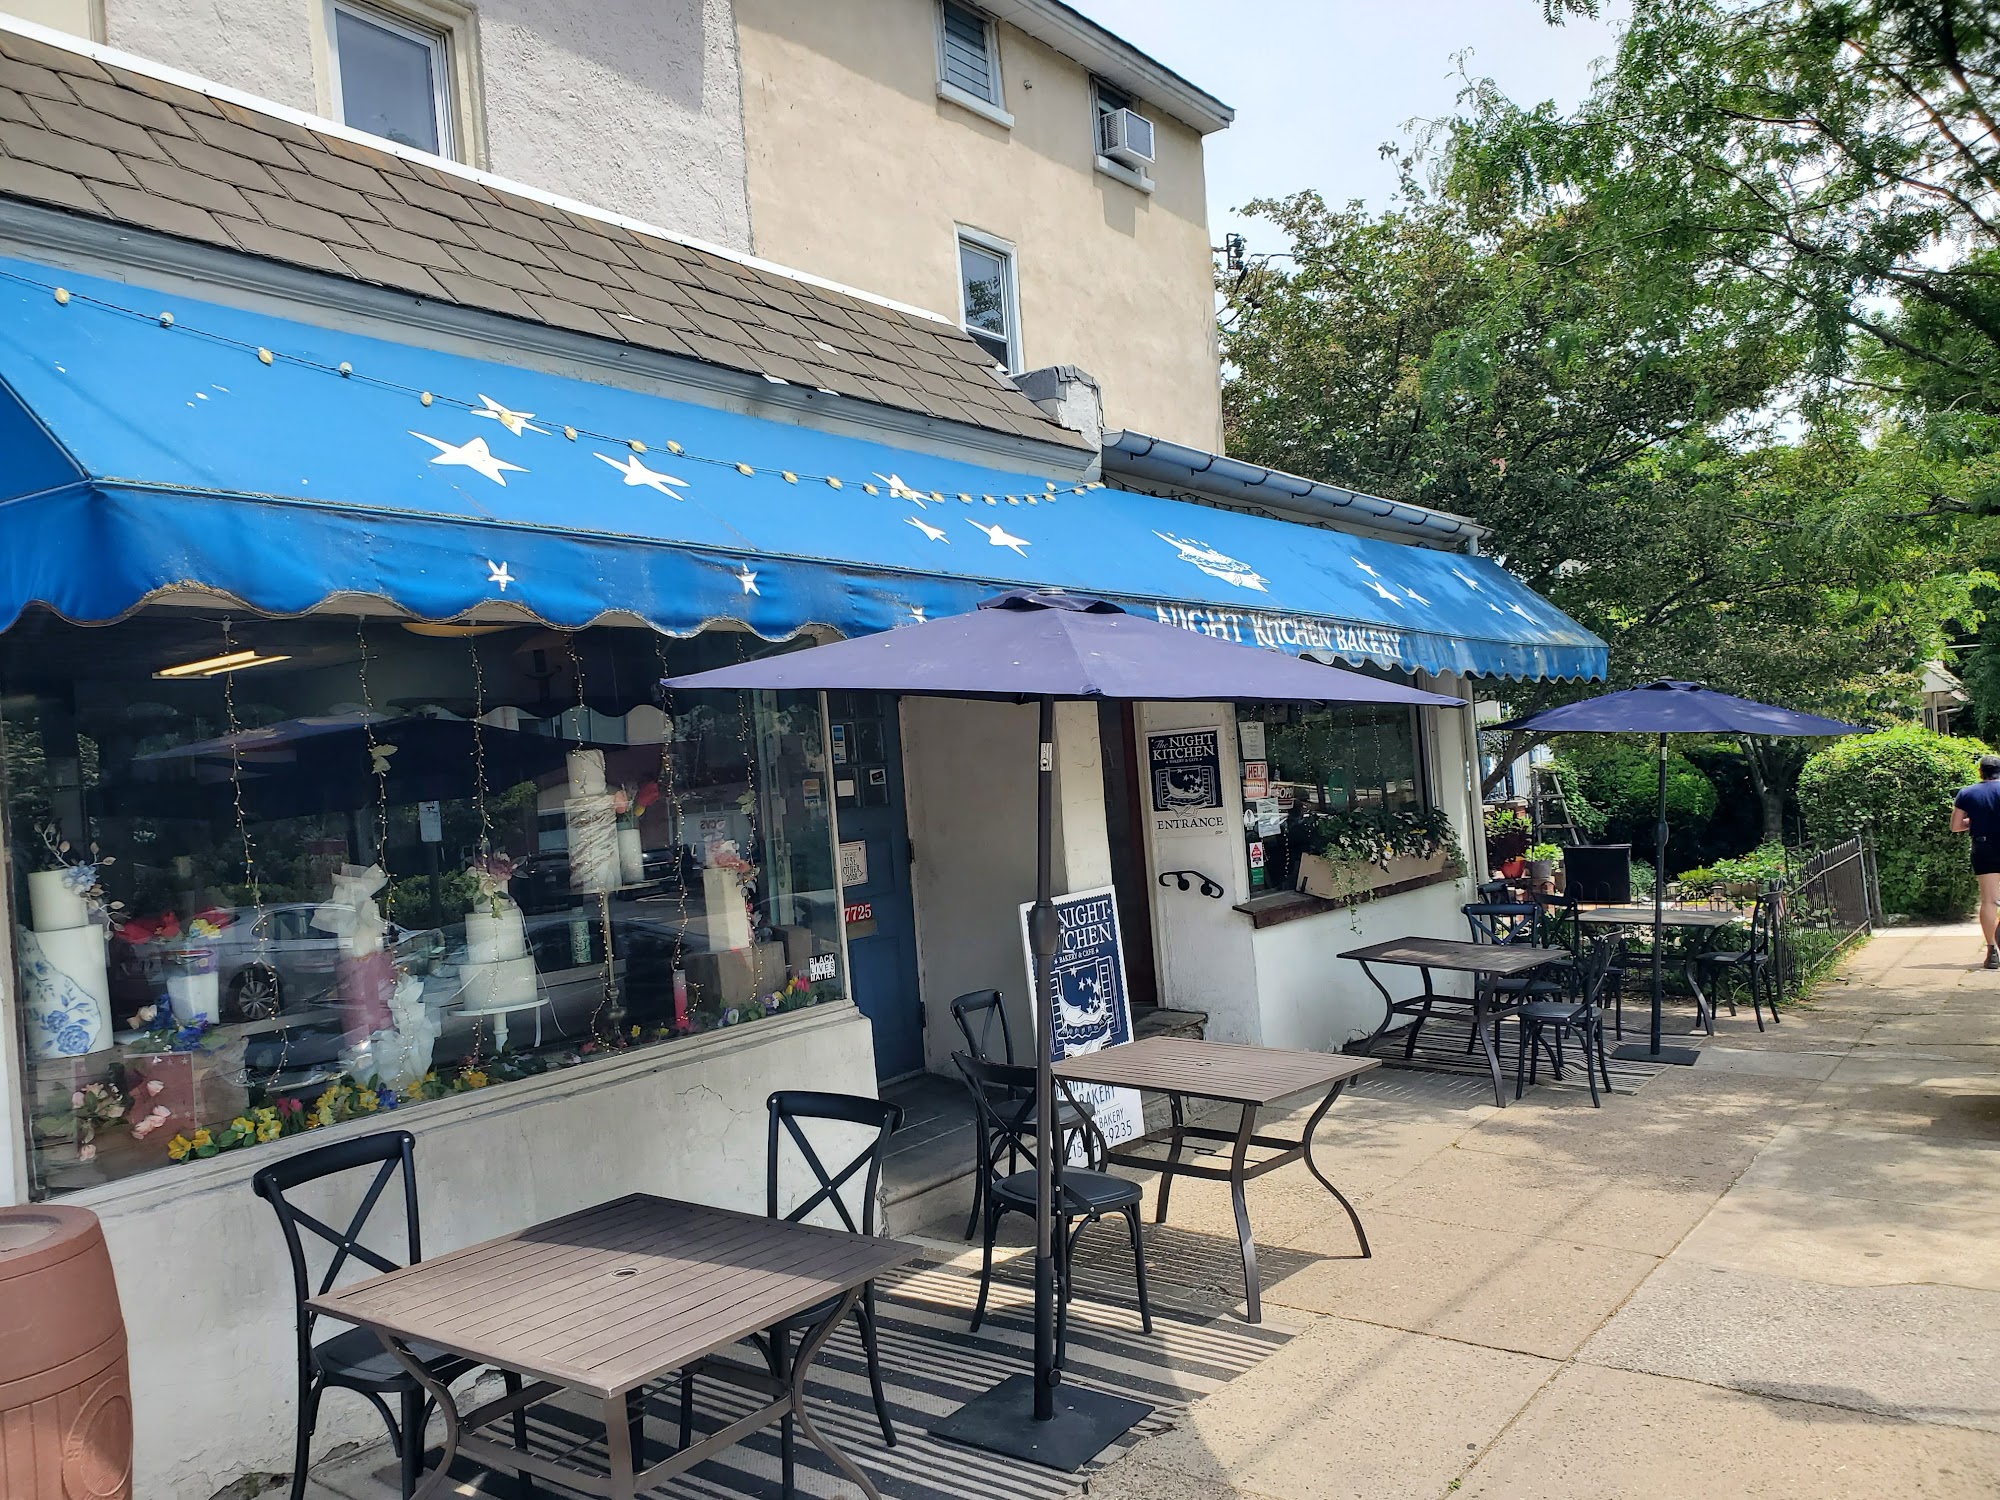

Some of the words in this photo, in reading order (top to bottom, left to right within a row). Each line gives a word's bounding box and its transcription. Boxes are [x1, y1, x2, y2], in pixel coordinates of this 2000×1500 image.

[1157, 606, 1243, 642] NIGHT
[1250, 613, 1333, 649] KITCHEN
[1334, 625, 1402, 658] BAKERY
[1153, 740, 1168, 749] The
[1169, 734, 1214, 748] NIGHT
[1153, 745, 1215, 760] KITCHEN
[1248, 765, 1265, 778] HELP
[1157, 817, 1224, 830] ENTRANCE
[845, 904, 872, 922] 7725
[1058, 900, 1109, 928] NIGHT
[809, 953, 835, 967] BLACK
[1059, 952, 1077, 963] BAKERY
[811, 963, 835, 973] LIVES
[811, 971, 836, 982] MATTER
[1099, 1108, 1124, 1128] BAKERY
